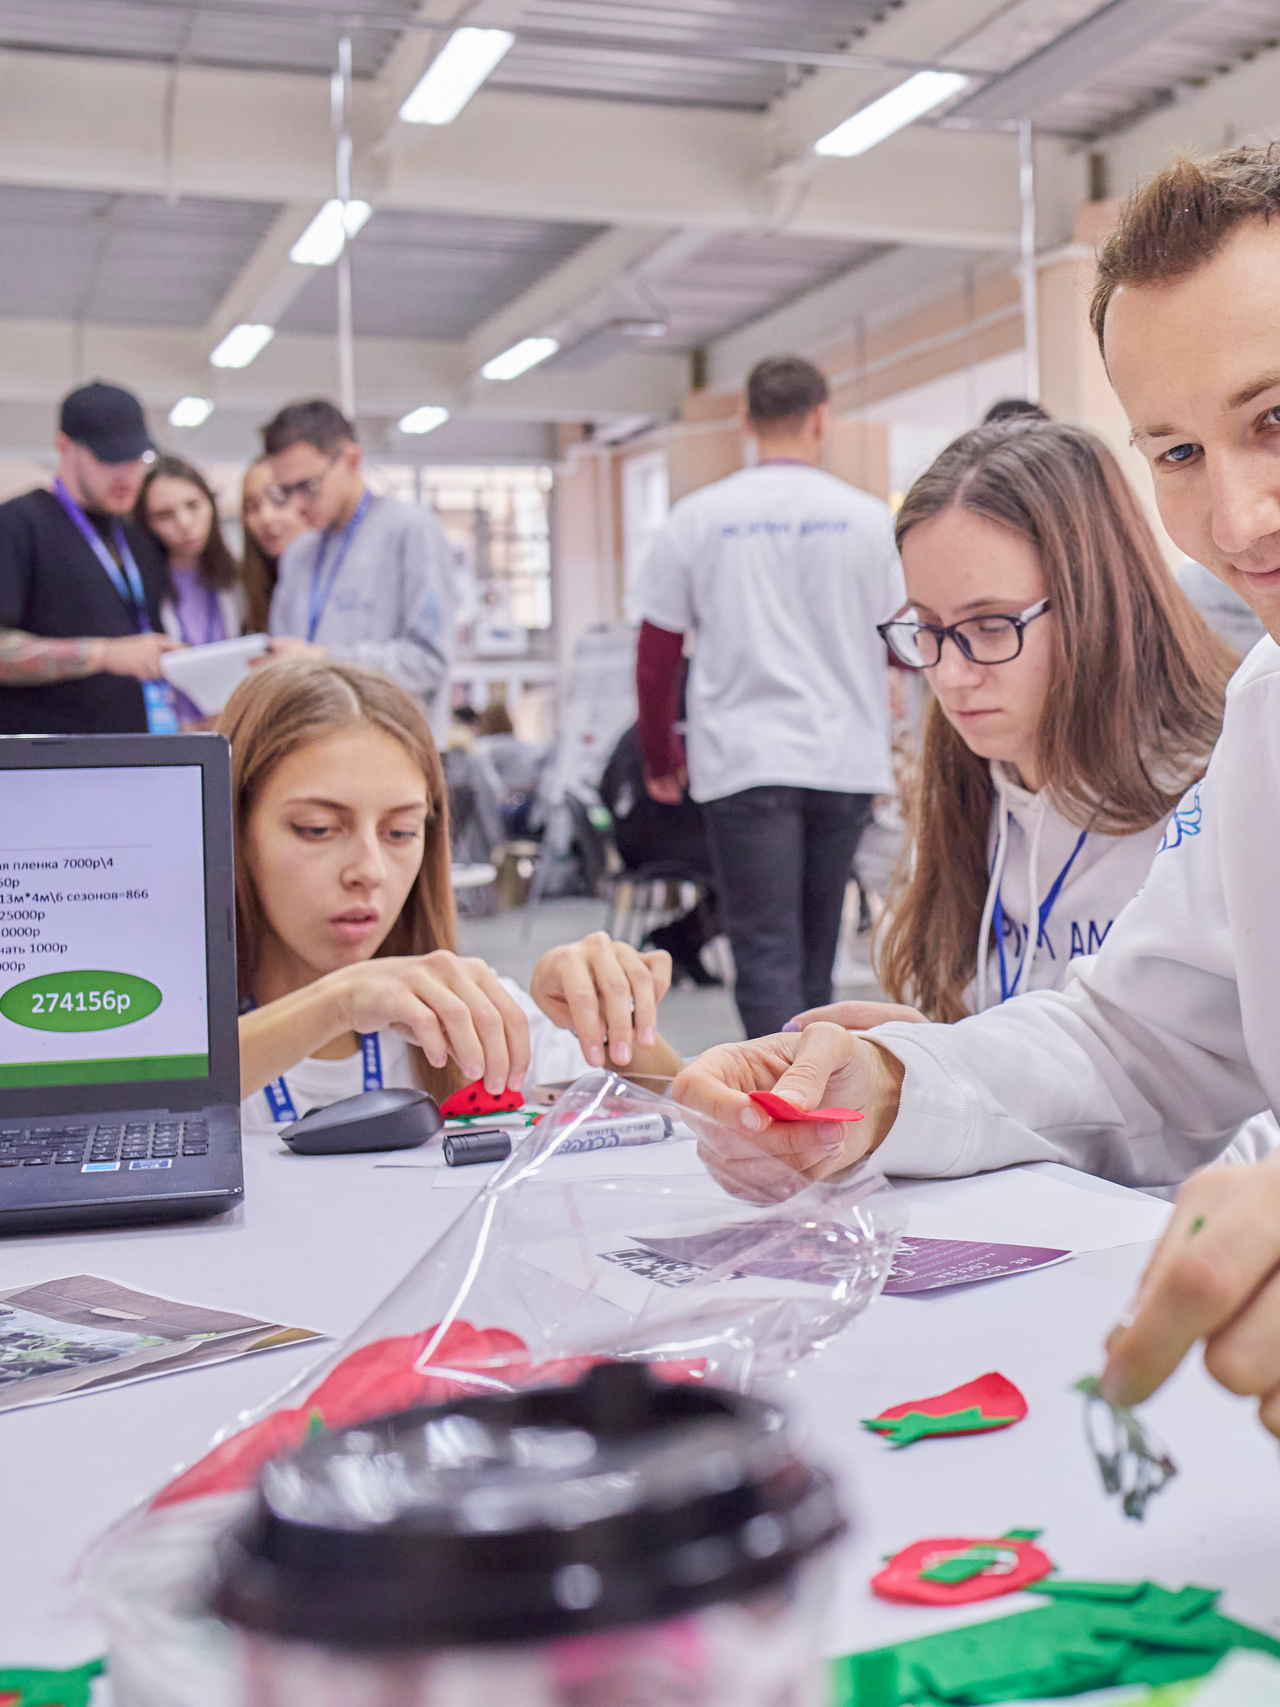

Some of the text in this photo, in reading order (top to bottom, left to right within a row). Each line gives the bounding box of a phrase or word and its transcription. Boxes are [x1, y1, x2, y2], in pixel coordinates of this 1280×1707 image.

[13, 861, 58, 871] пленка
[30, 943, 68, 954] 1000р
[0, 961, 26, 973] 00р
[31, 989, 131, 1015] 274156р
[586, 1126, 616, 1137] WHITE
